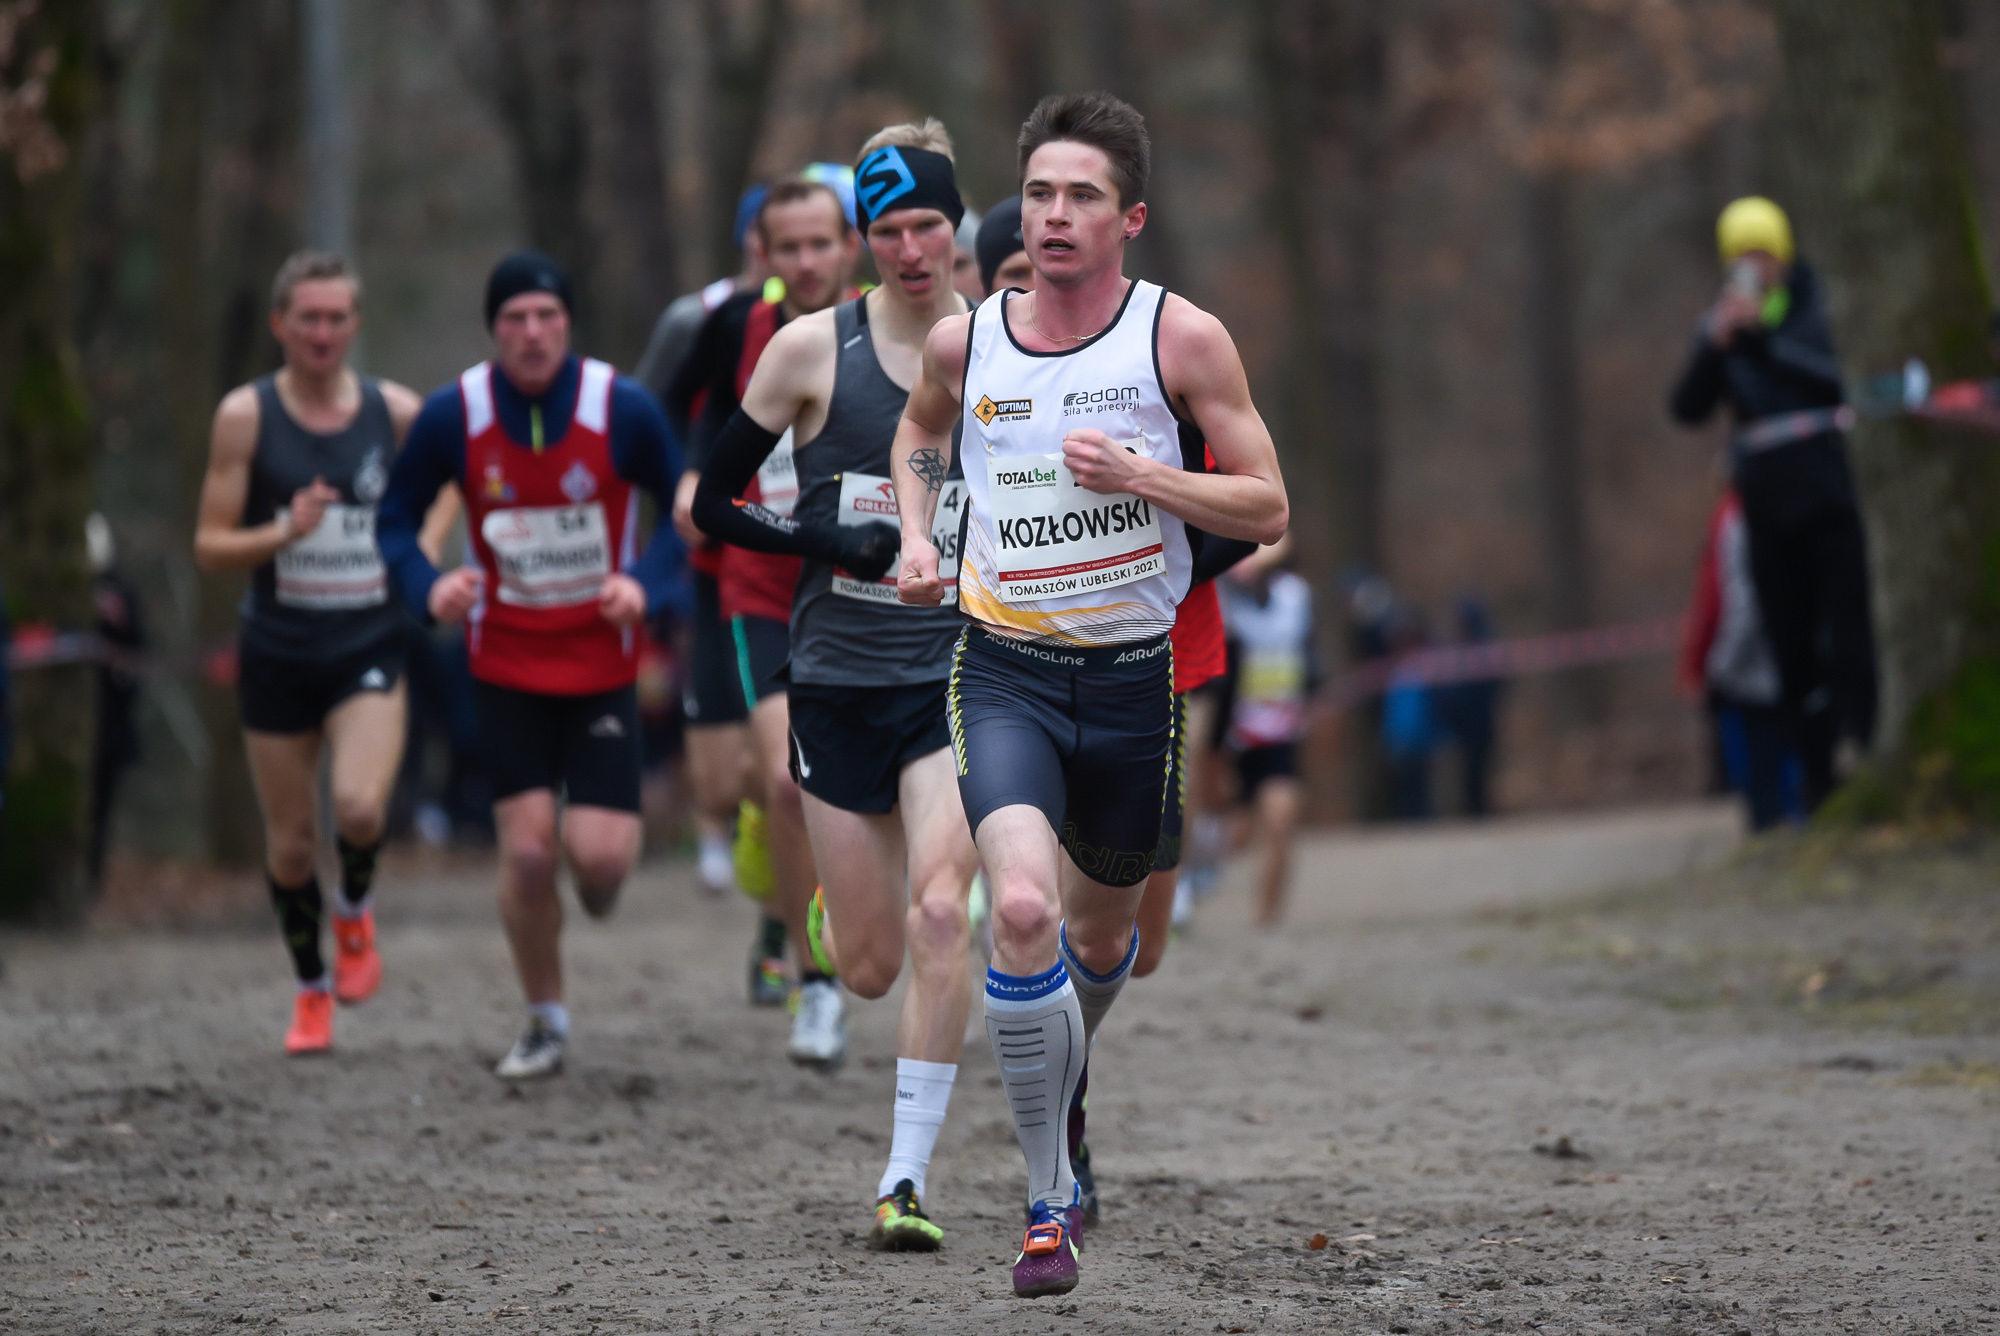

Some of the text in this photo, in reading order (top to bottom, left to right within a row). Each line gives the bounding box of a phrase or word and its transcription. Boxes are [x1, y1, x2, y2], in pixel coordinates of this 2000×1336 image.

[998, 401, 1030, 413] OPTIMA
[1064, 401, 1140, 416] siła w precyzji
[996, 467, 1057, 486] TOTALbet
[855, 500, 897, 514] ORLEN
[999, 498, 1152, 550] KOZŁOWSKI
[1009, 558, 1158, 597] TOMASZÓW LUBELSKI 2021
